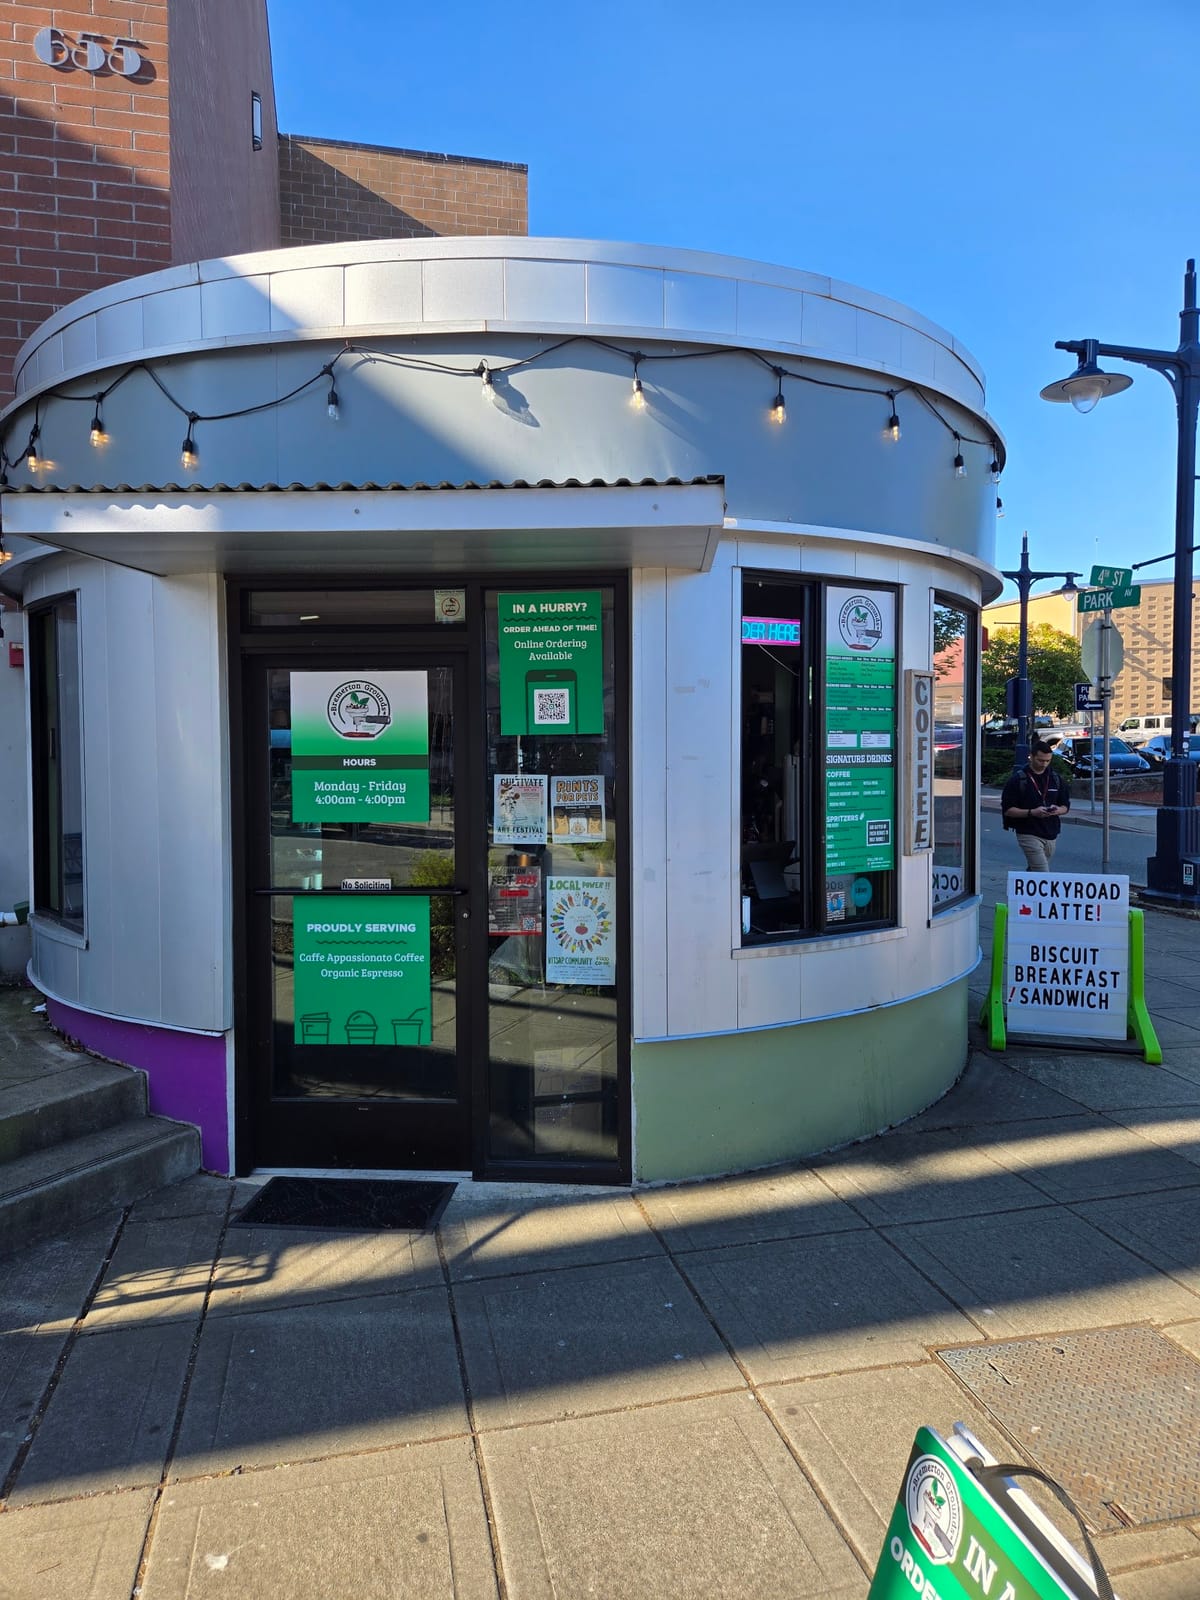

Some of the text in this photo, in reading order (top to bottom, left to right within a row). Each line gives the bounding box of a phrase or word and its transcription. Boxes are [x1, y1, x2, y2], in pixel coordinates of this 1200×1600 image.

[33, 26, 141, 75] 655
[1112, 570, 1125, 586] ST
[1084, 592, 1113, 609] PARK
[512, 602, 588, 614] IN A HURRY?
[768, 623, 799, 642] HERE
[514, 639, 587, 649] Online Ordering
[529, 651, 573, 661] Available
[331, 684, 387, 711] Bremerton Grounds
[343, 758, 376, 767] HOURS
[826, 754, 892, 763] SIGNATURE DRINKS
[915, 680, 930, 843] COFFEE
[314, 781, 360, 793] Monday
[368, 781, 406, 792] Friday
[501, 778, 544, 786] CULTIVATE
[315, 795, 356, 805] 4:00am
[365, 795, 406, 806] 4:00pm
[556, 792, 599, 802] FOR PETS
[342, 881, 390, 889] No Soliciting
[549, 880, 581, 890] LOCAL
[1038, 902, 1101, 921] LATTE!
[307, 923, 416, 933] PROUDLY SERVING
[300, 953, 425, 964] Caffe Appassionato Coffee
[1031, 945, 1099, 965] BISCUIT
[320, 968, 404, 979] Organic Espresso
[1015, 965, 1120, 988] BREAKFAST
[1020, 987, 1109, 1010] SANDWICH
[914, 1463, 957, 1534] Bremerton Grounds
[891, 1536, 942, 1600] ORDE
[963, 1535, 998, 1595] IN
